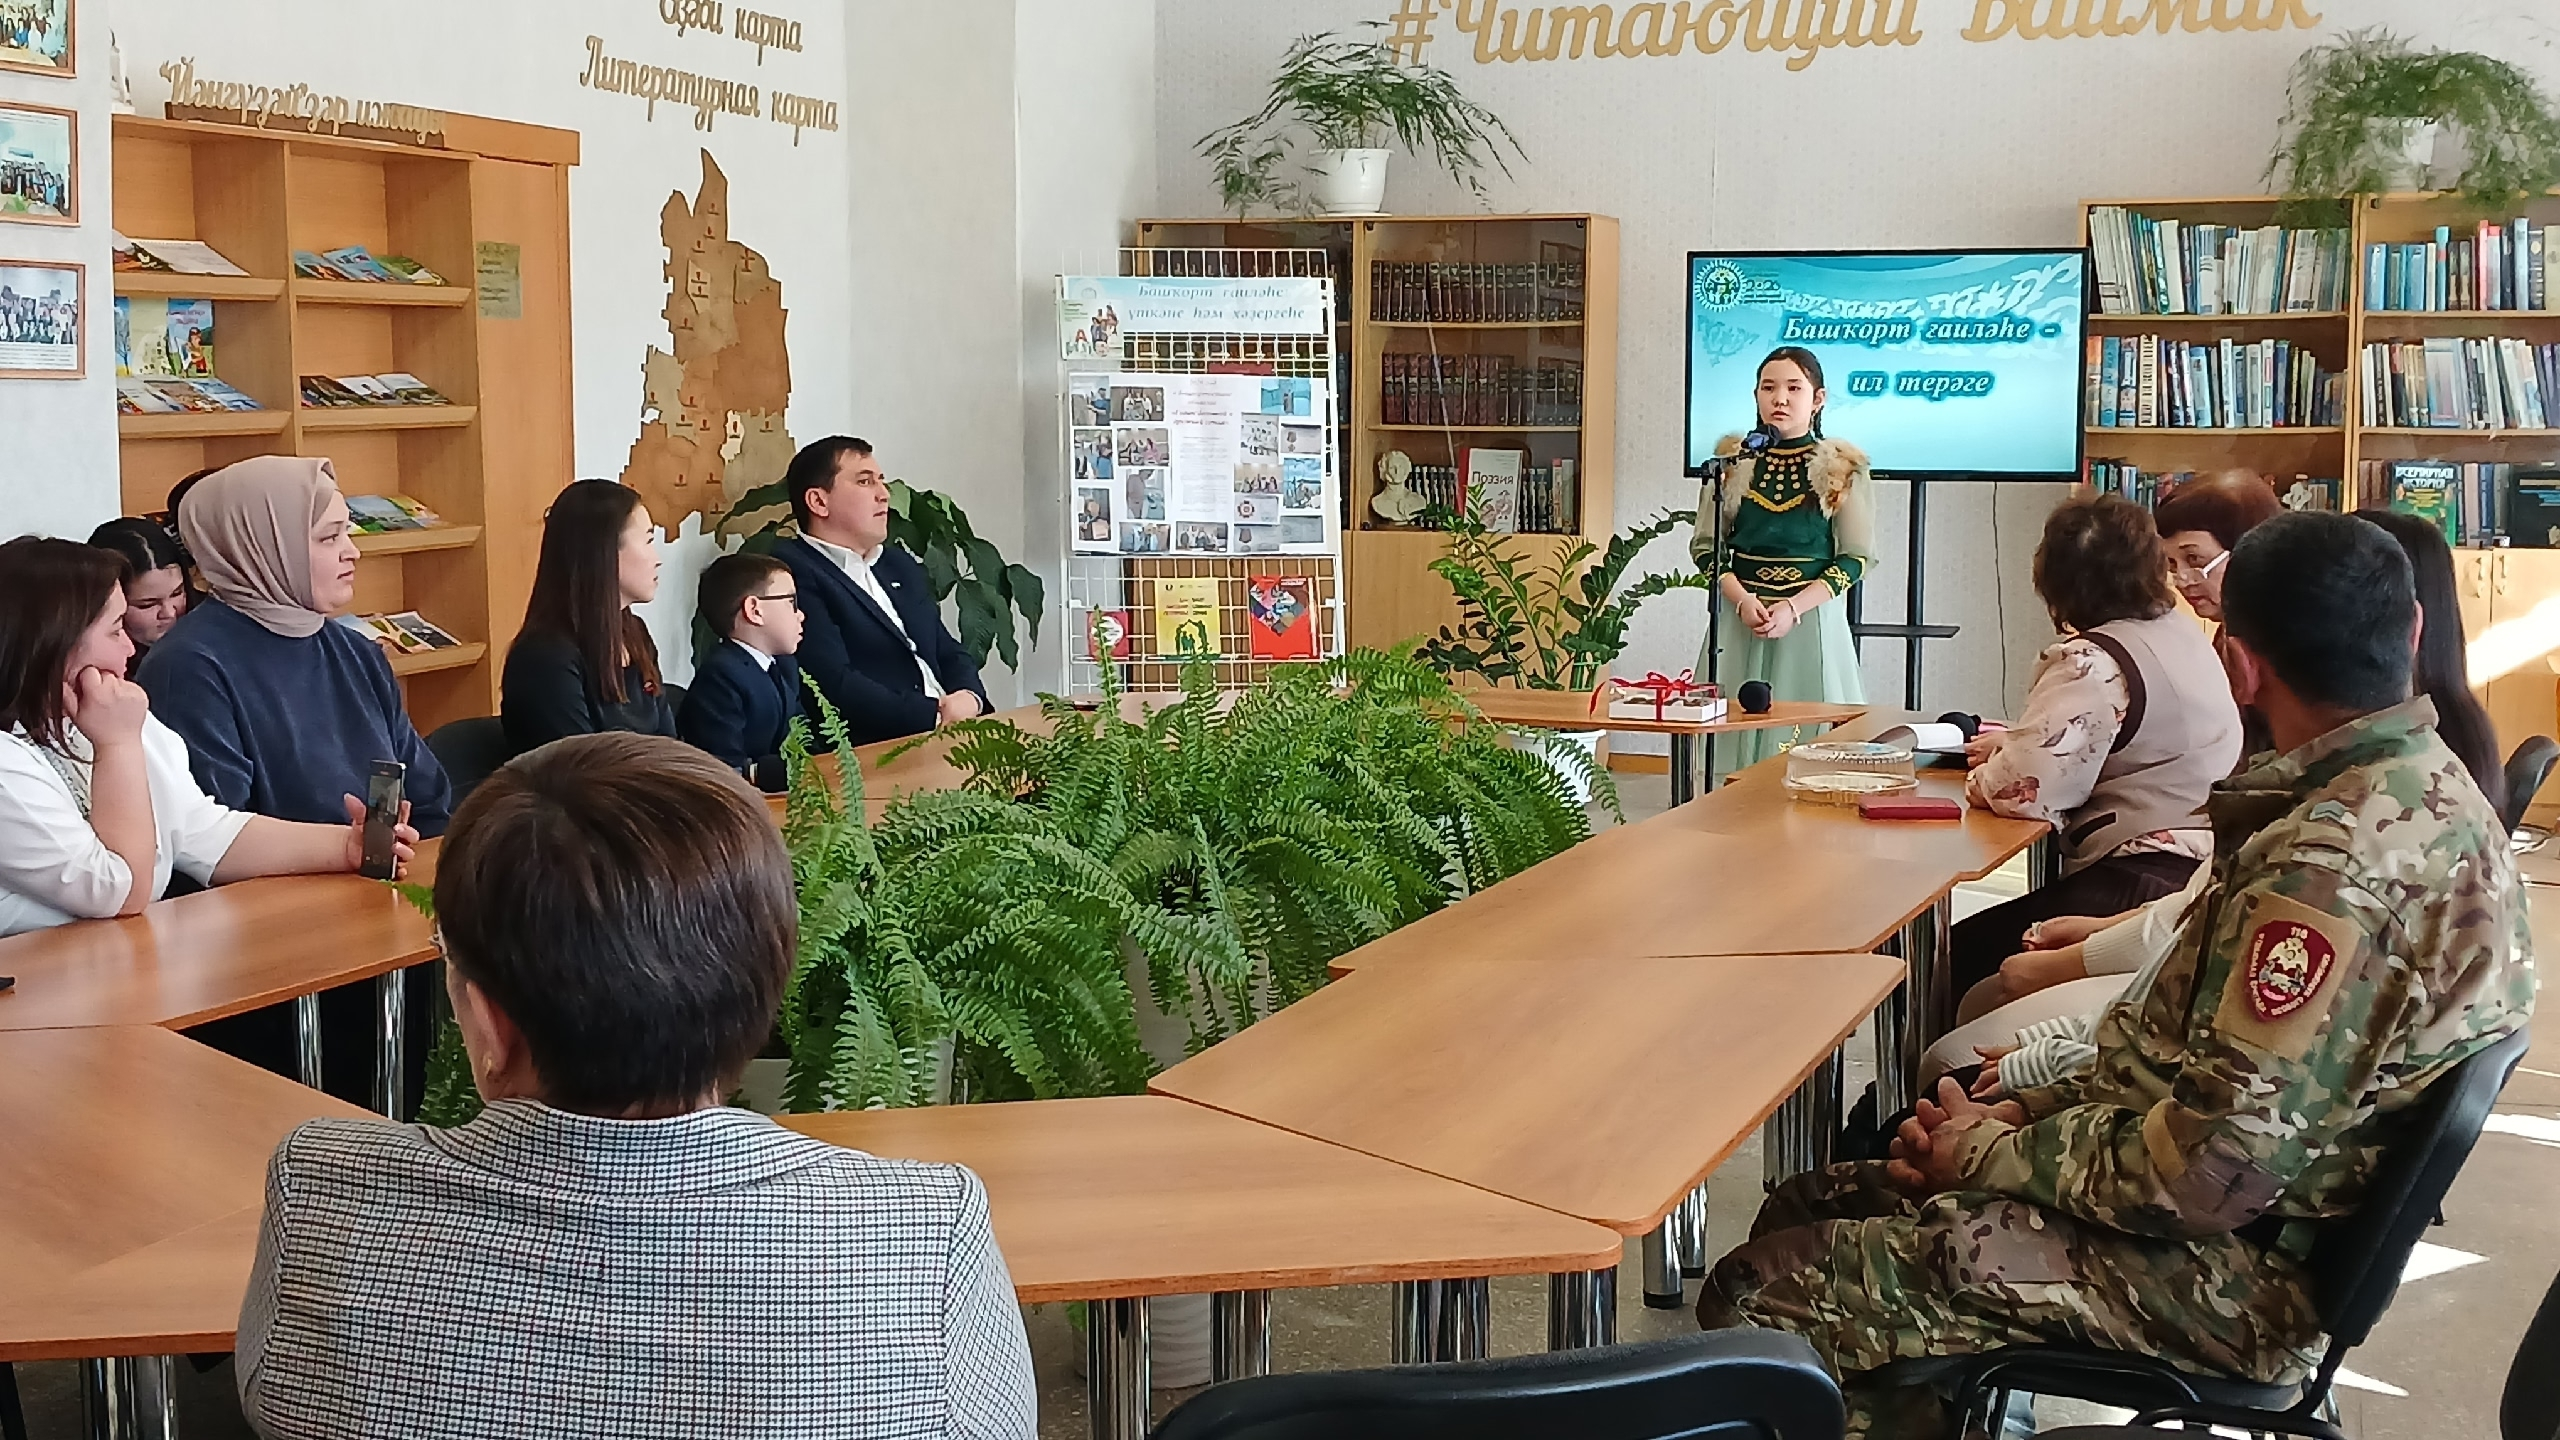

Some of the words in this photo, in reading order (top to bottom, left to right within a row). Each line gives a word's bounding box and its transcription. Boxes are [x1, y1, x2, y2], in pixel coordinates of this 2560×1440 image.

[735, 8, 803, 66] карта
[580, 35, 760, 132] Литературная
[771, 91, 838, 147] карта
[1852, 376, 1884, 392] ил
[1898, 376, 1989, 398] терәге
[1472, 470, 1514, 484] Поэзия
